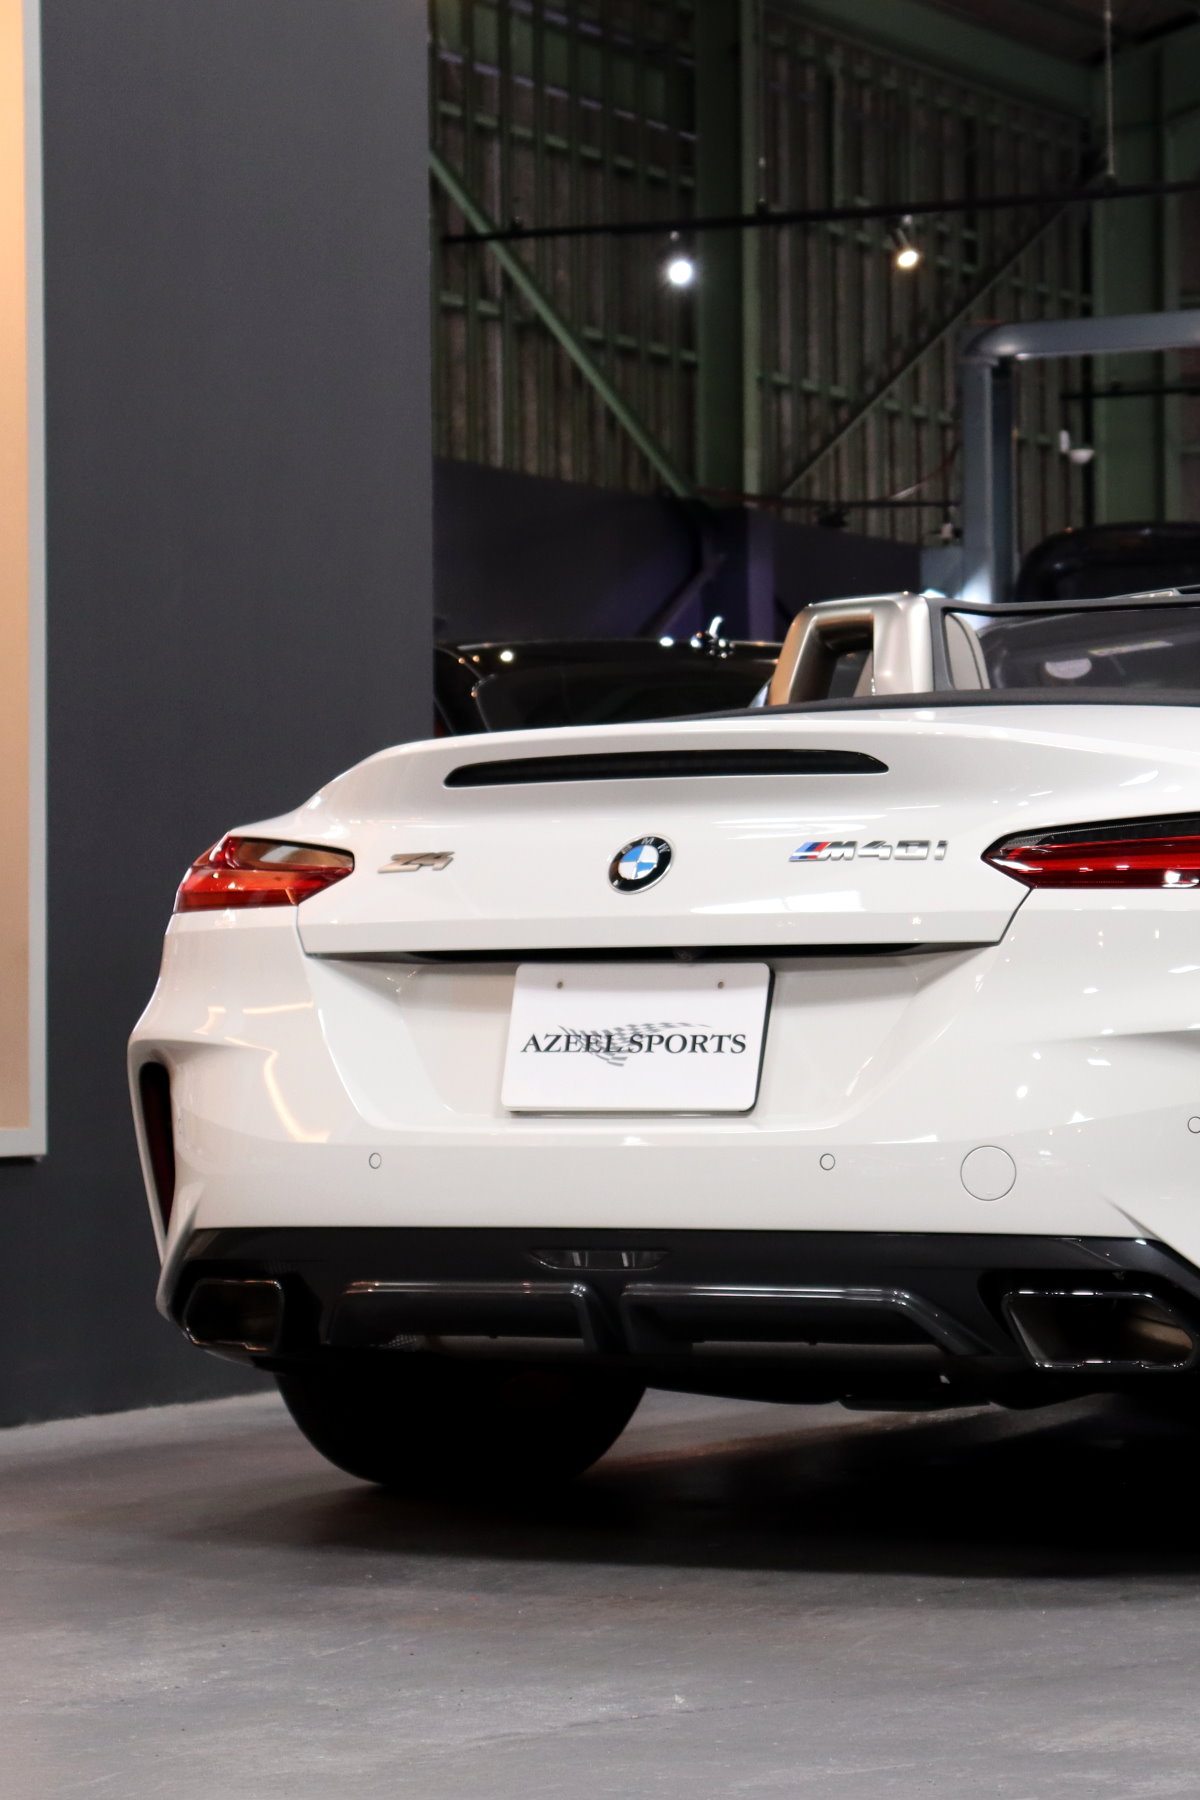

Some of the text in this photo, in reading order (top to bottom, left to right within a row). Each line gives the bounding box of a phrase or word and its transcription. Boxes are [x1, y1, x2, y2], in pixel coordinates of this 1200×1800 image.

[377, 850, 455, 874] Z4
[520, 1032, 747, 1054] AZEEL SPORTS
